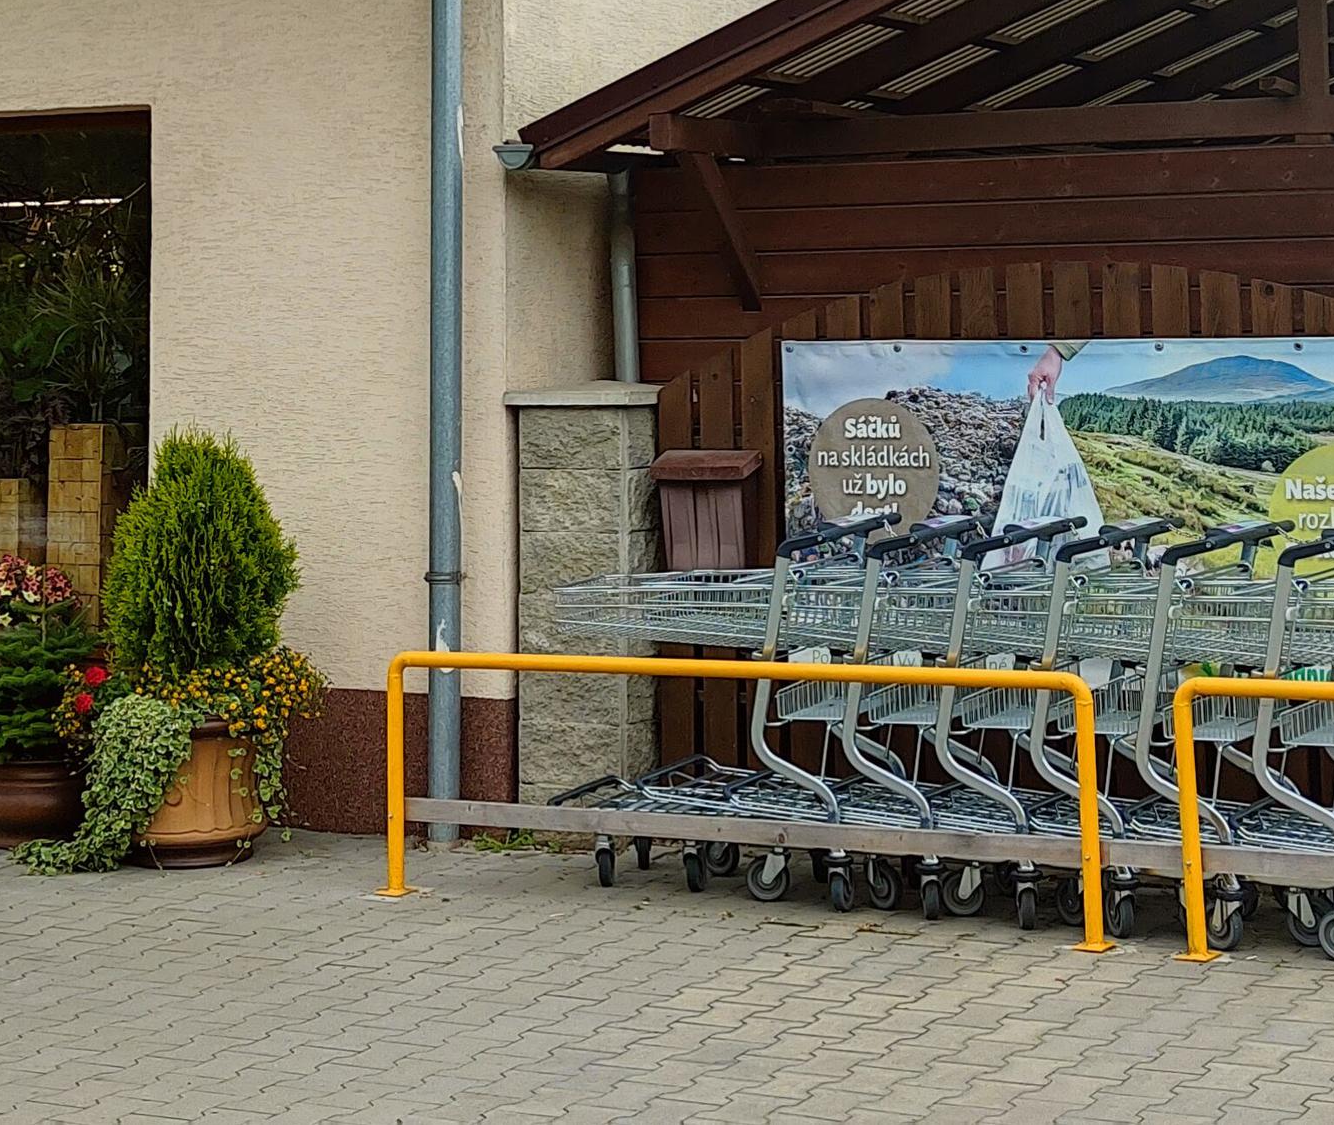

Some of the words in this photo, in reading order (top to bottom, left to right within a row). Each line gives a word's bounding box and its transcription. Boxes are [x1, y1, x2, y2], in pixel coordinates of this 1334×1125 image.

[845, 416, 901, 438] Sáčků
[817, 450, 839, 467] na
[842, 445, 930, 467] skládkách
[842, 473, 864, 495] už
[865, 473, 907, 500] bylo
